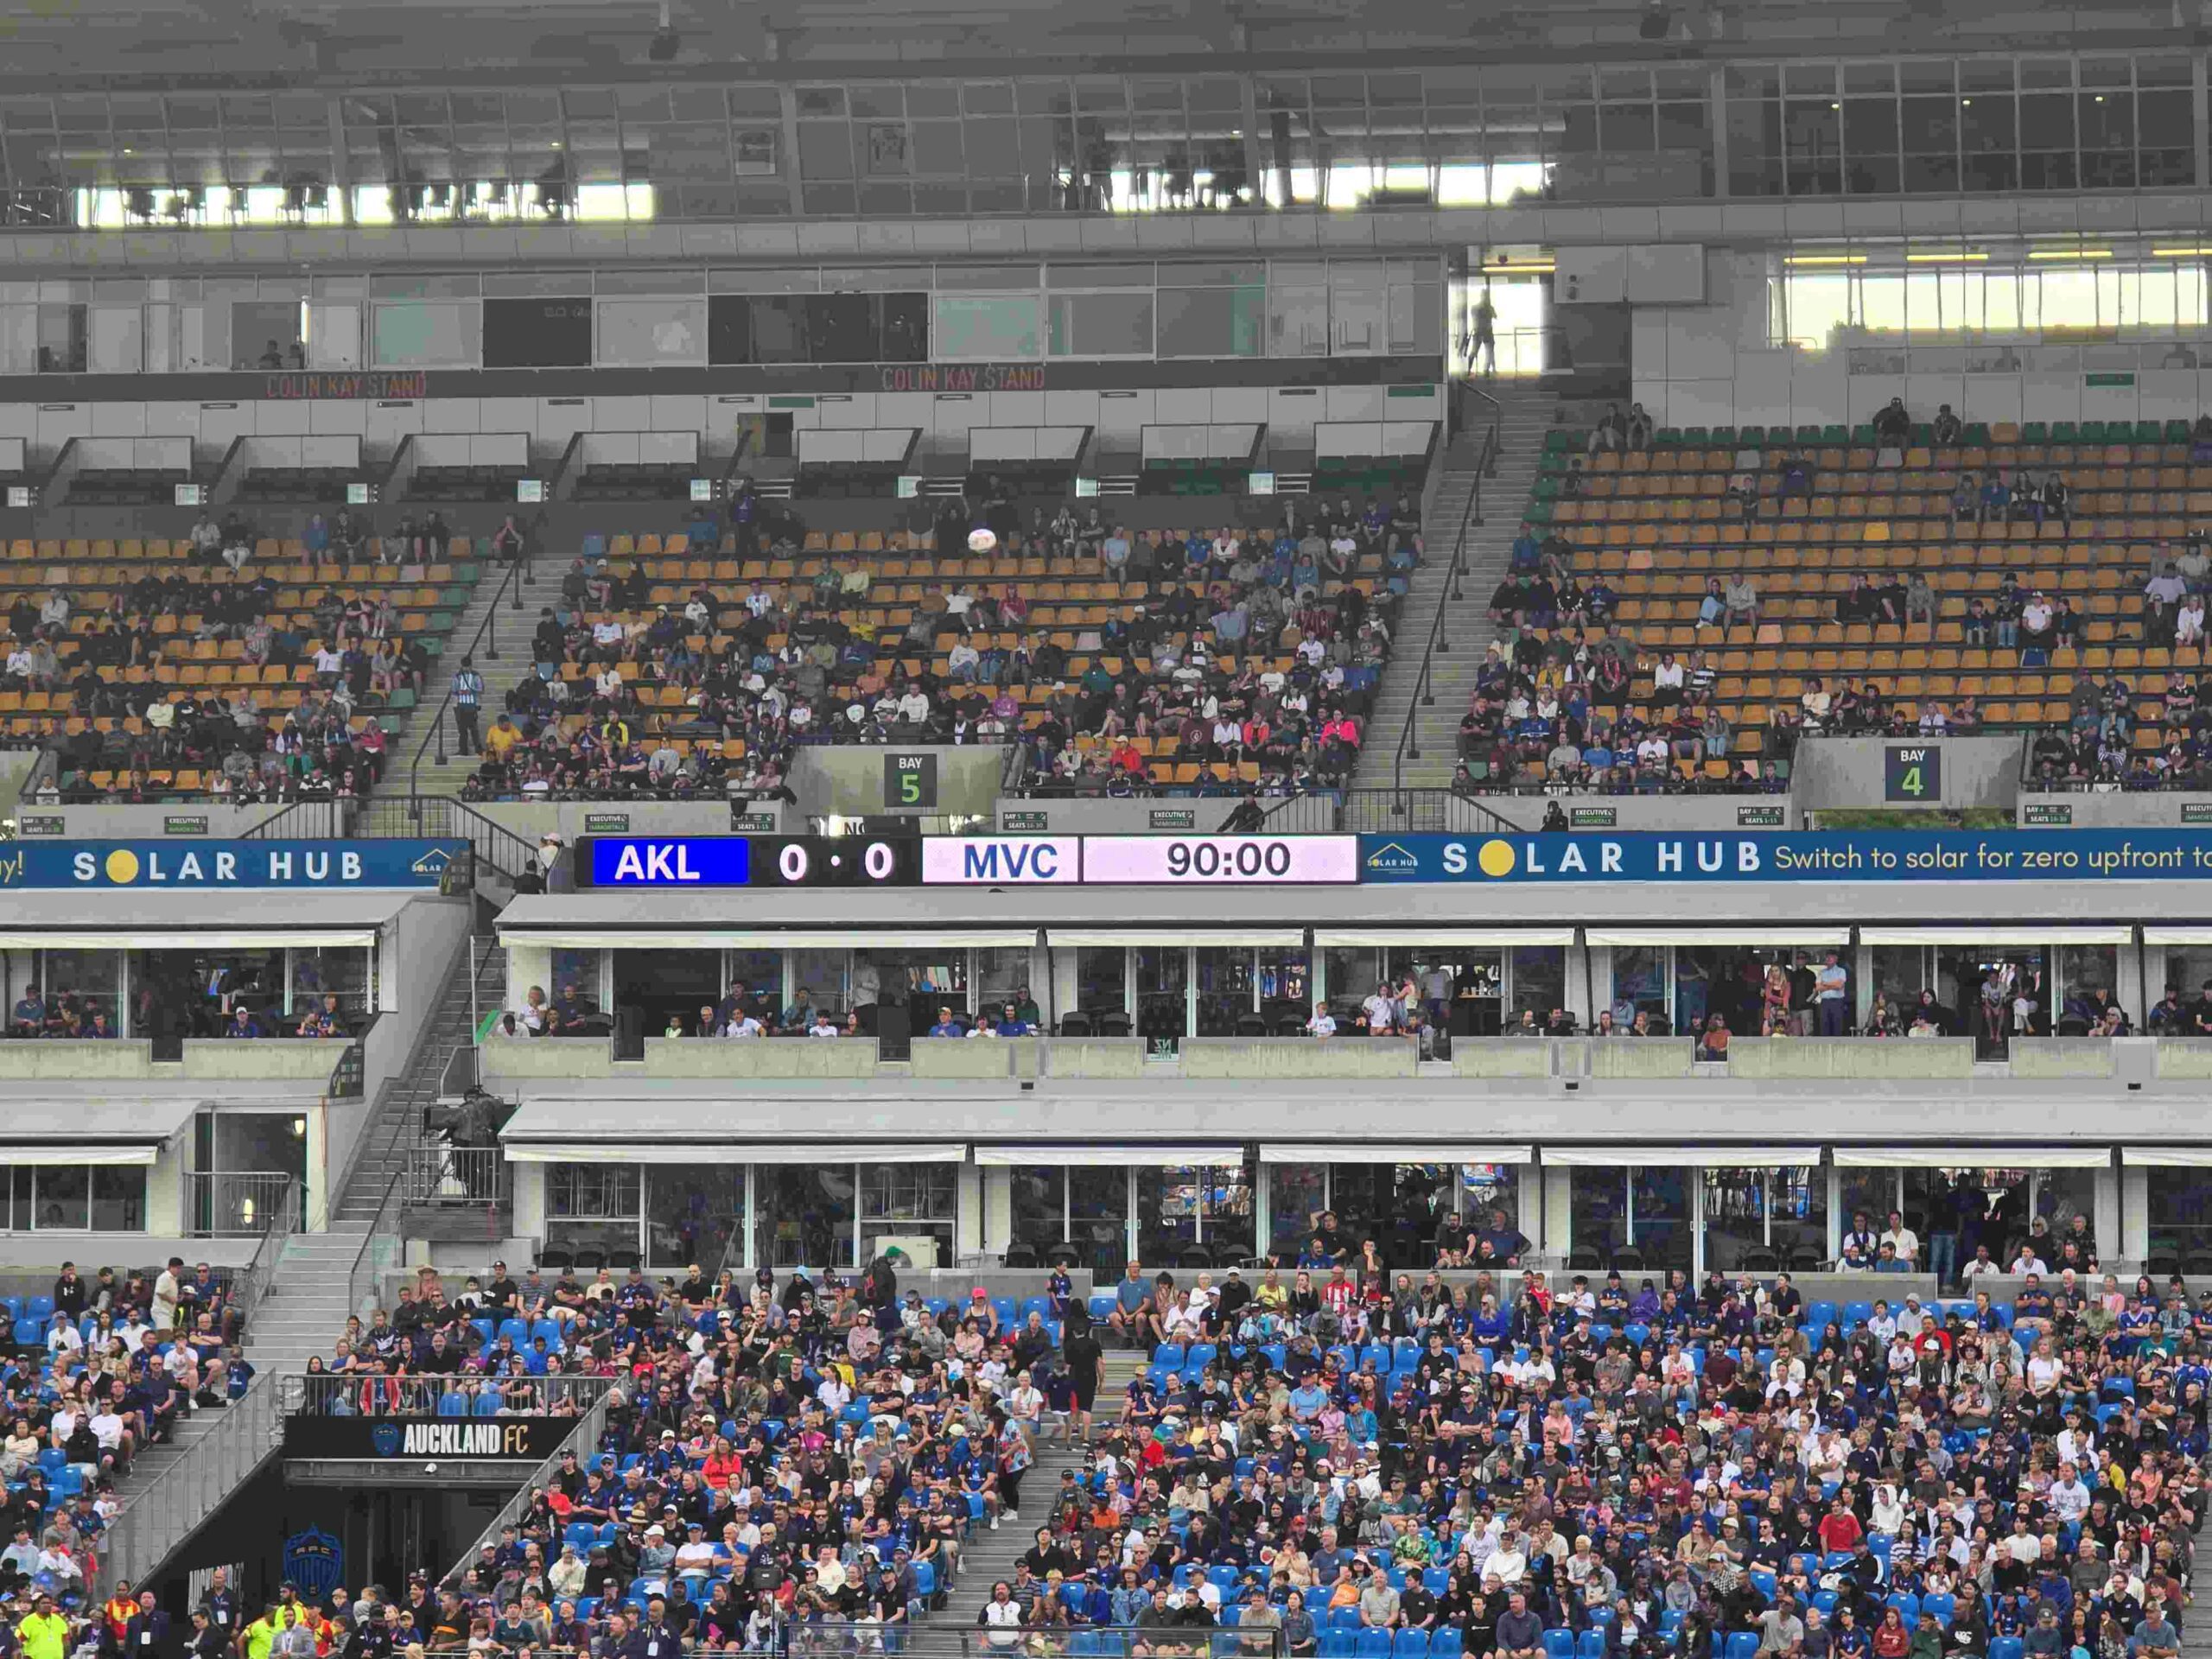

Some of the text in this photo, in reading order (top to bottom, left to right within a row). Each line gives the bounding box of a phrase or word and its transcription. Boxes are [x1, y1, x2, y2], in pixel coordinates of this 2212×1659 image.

[266, 373, 426, 397] COLIN KAY STAND
[882, 366, 1045, 390] COLIN KAY STAND
[899, 758, 922, 769] BAY
[1900, 750, 1925, 762] BAY
[901, 774, 920, 803] 5
[1901, 767, 1923, 797] 4
[0, 850, 23, 883] y!
[270, 852, 362, 880] HUB
[614, 841, 1291, 880] AKL 0 0 MVC 90:00
[1657, 841, 1761, 873] HUB
[1776, 843, 1862, 868] Switch
[1871, 845, 1897, 868] to
[1906, 842, 1968, 868] solar
[1976, 842, 2012, 868] for
[2021, 849, 2079, 868] zero
[2088, 842, 2183, 874] upfront
[403, 1423, 529, 1454] AUCKLAND FC
